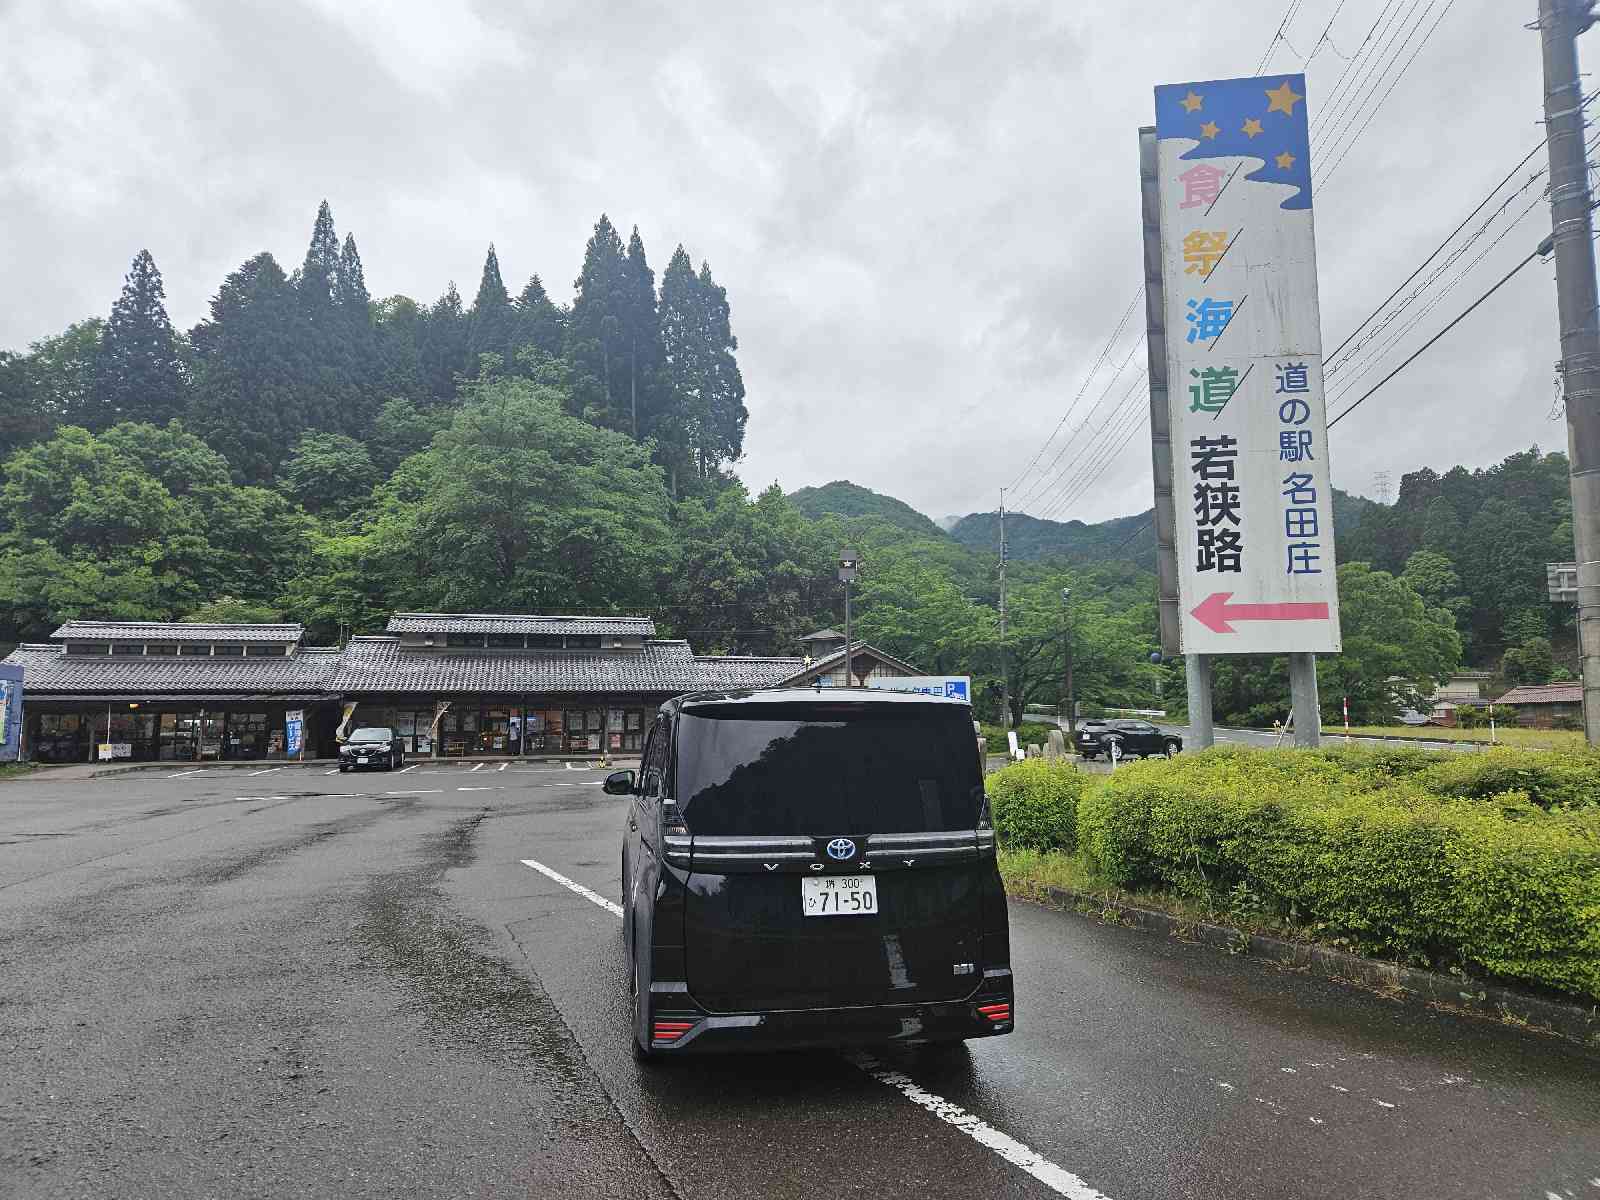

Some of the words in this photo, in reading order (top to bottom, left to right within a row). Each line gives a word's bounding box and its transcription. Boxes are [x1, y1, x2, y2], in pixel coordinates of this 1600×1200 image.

[1275, 361, 1315, 463] 道の駅
[1190, 434, 1244, 573] 若狭路
[1281, 471, 1322, 575] 名田庄
[763, 859, 915, 871] VOXY
[842, 878, 860, 889] 300
[819, 891, 873, 912] 71-50
